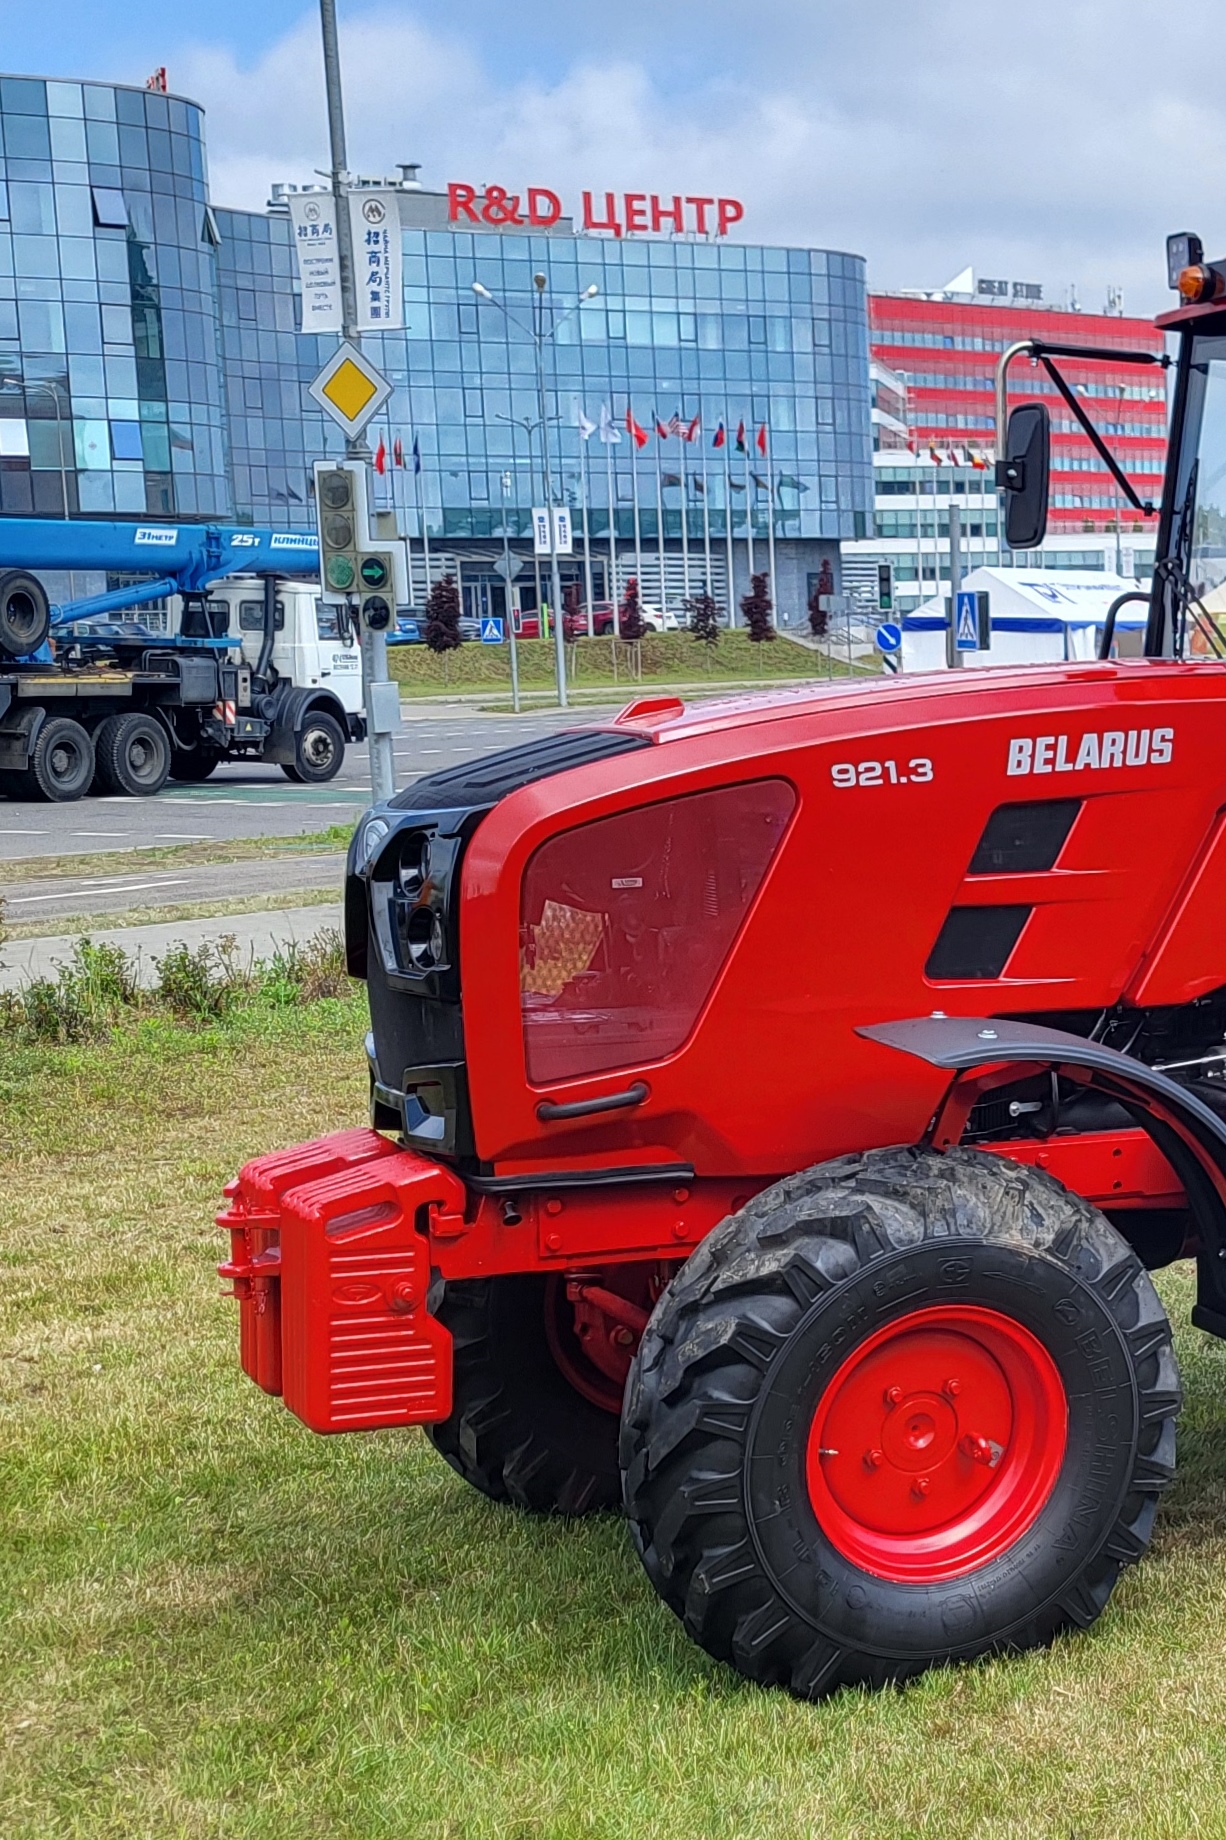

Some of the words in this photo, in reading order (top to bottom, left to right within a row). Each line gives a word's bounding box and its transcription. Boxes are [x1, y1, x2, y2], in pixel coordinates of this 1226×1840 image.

[297, 223, 332, 237] 招商局
[447, 182, 562, 228] R&D
[581, 190, 745, 238] ЦЕНТР
[831, 757, 935, 788] 921.3
[1006, 727, 1175, 776] BELARUS
[1053, 1328, 1119, 1550] BELSHINA
